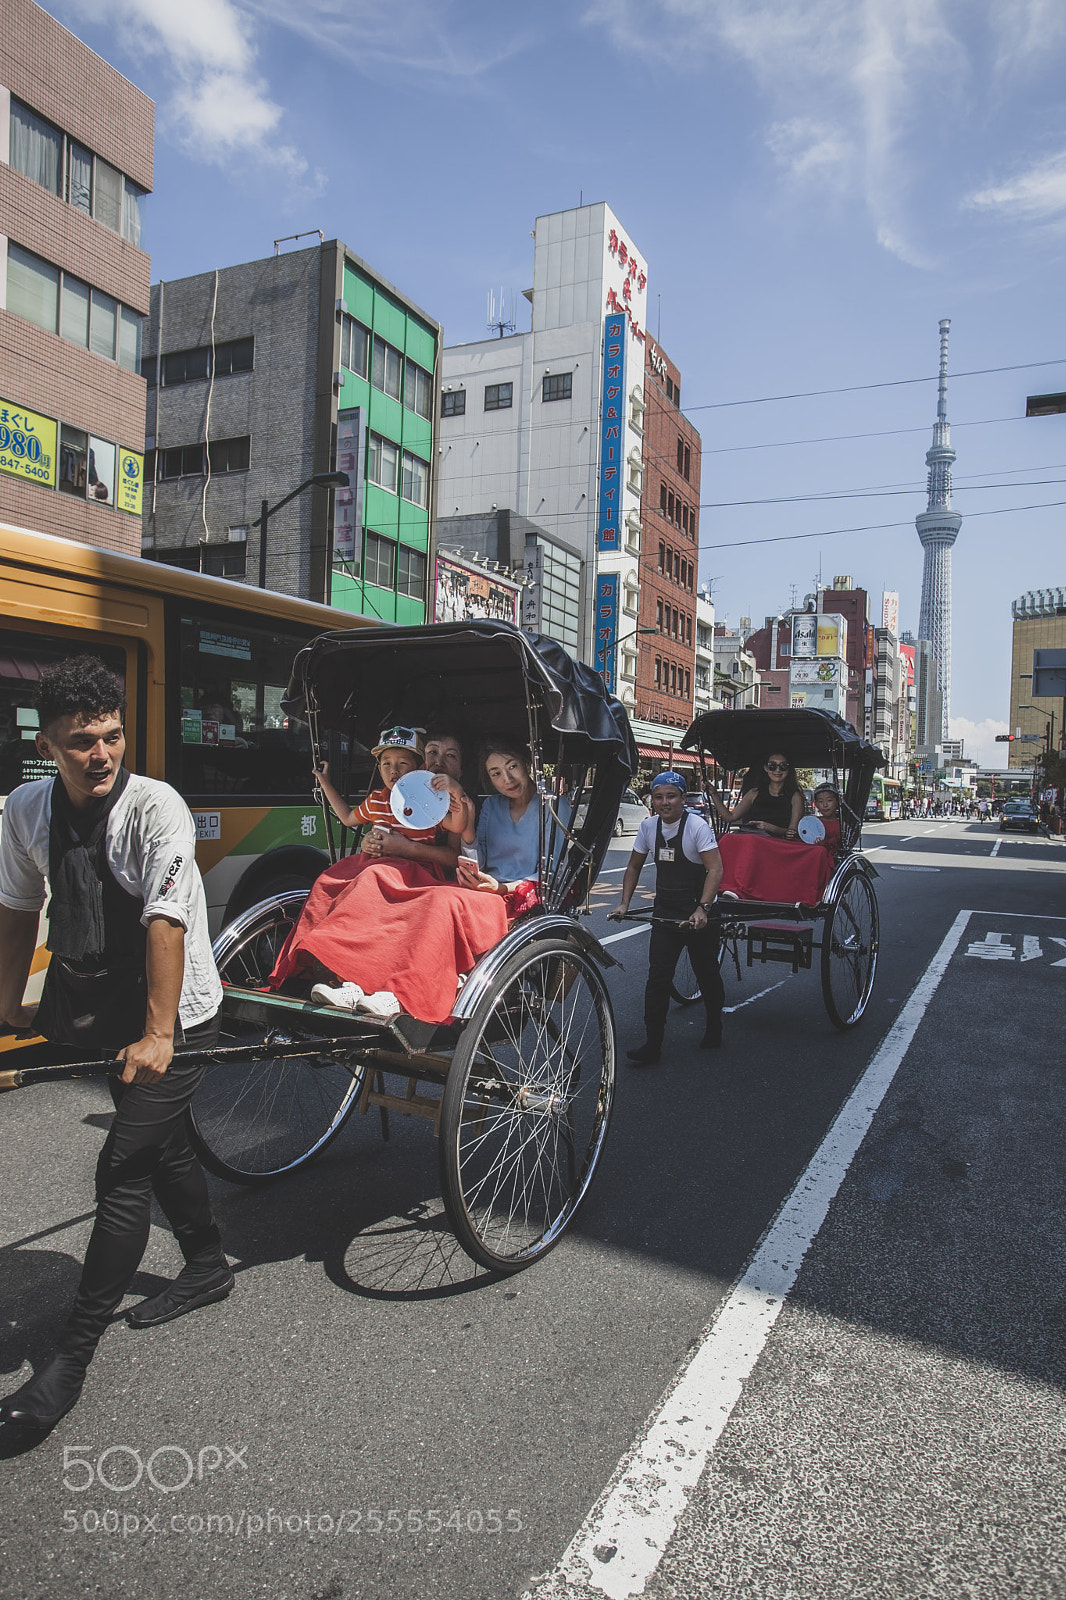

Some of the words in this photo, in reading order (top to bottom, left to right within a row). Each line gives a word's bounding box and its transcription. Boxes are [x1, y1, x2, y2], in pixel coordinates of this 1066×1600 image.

[609, 229, 647, 290] カラオケ
[794, 629, 816, 639] Asahi
[197, 815, 218, 829] 出口
[301, 814, 317, 837] 都
[199, 830, 216, 838] EXIT
